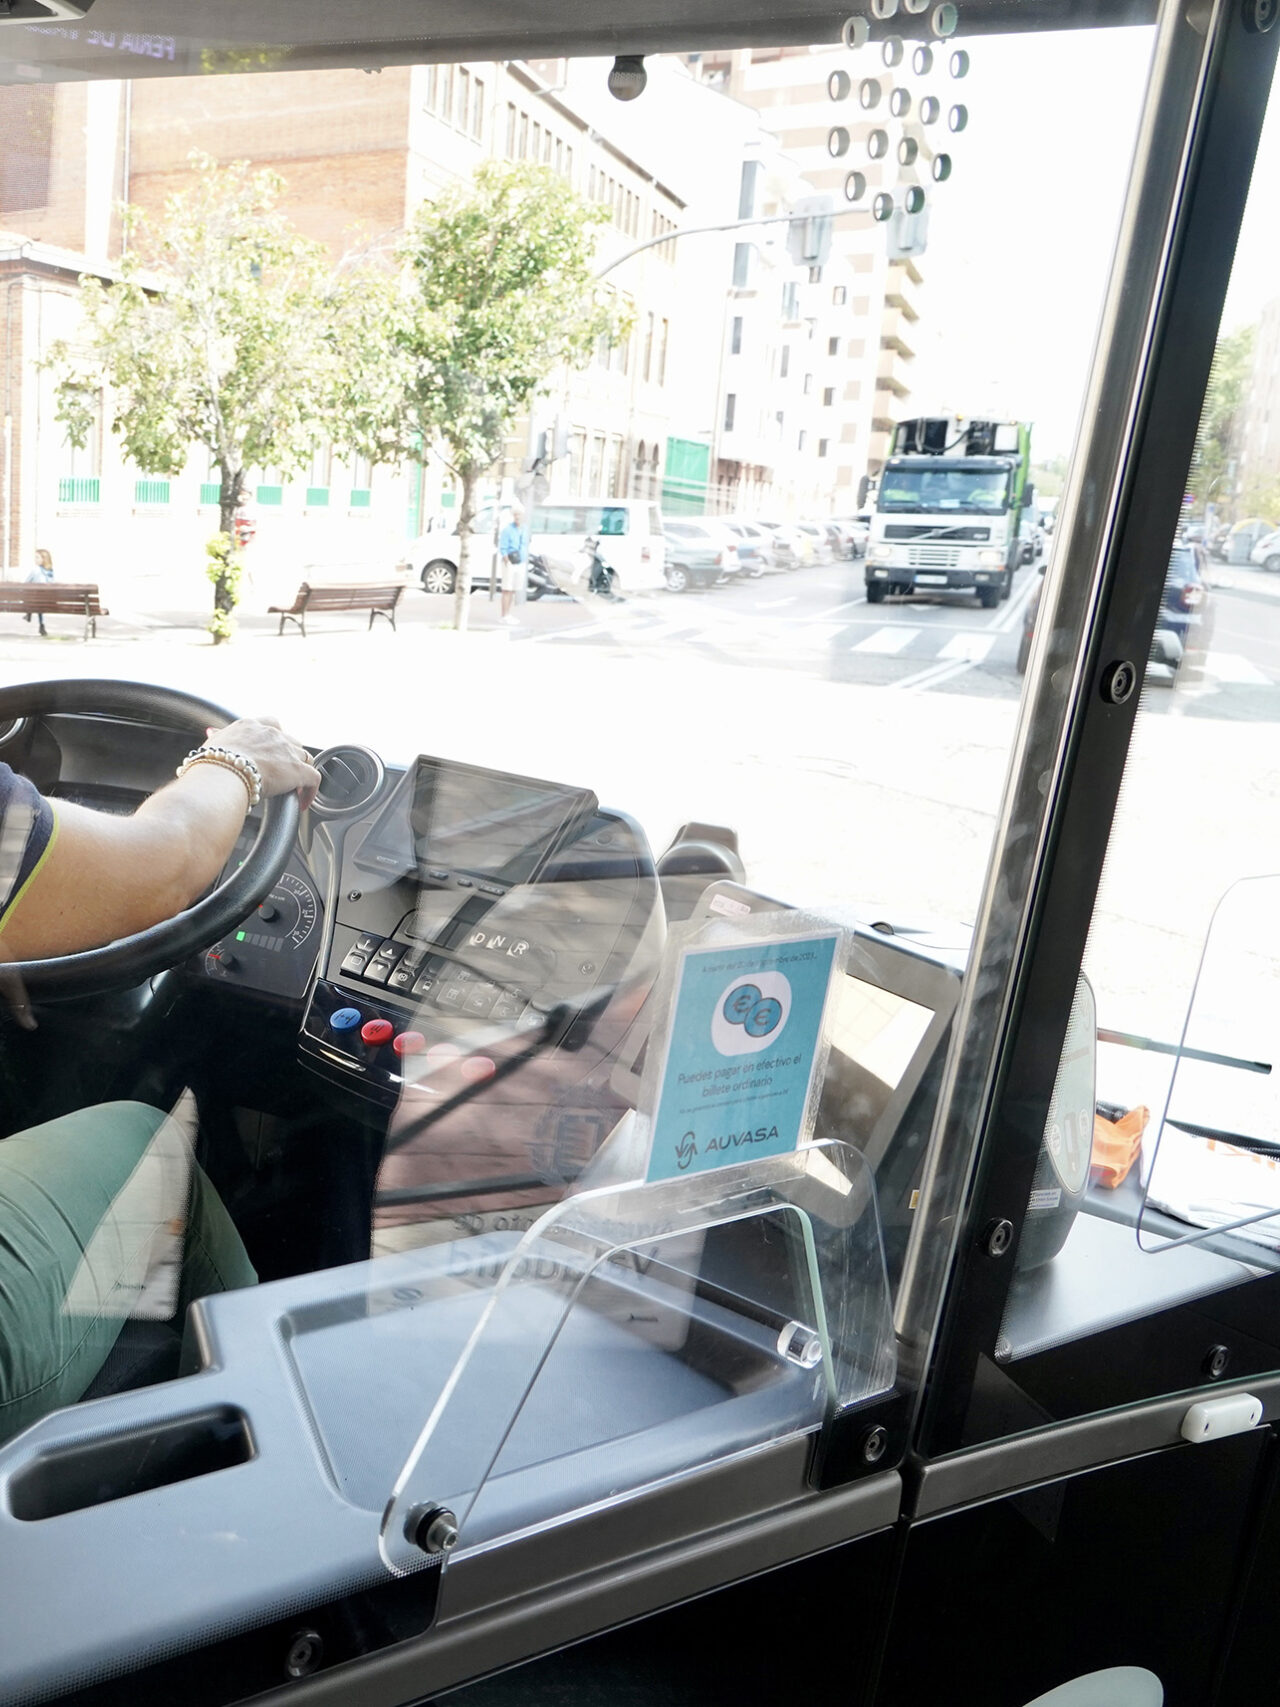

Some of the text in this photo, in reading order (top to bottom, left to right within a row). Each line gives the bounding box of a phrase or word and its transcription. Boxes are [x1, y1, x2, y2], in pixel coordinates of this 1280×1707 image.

[677, 1053, 803, 1085] Puedes pagar en efectivo el
[702, 1075, 773, 1098] billete ordinario
[704, 1125, 780, 1154] AUVASA
